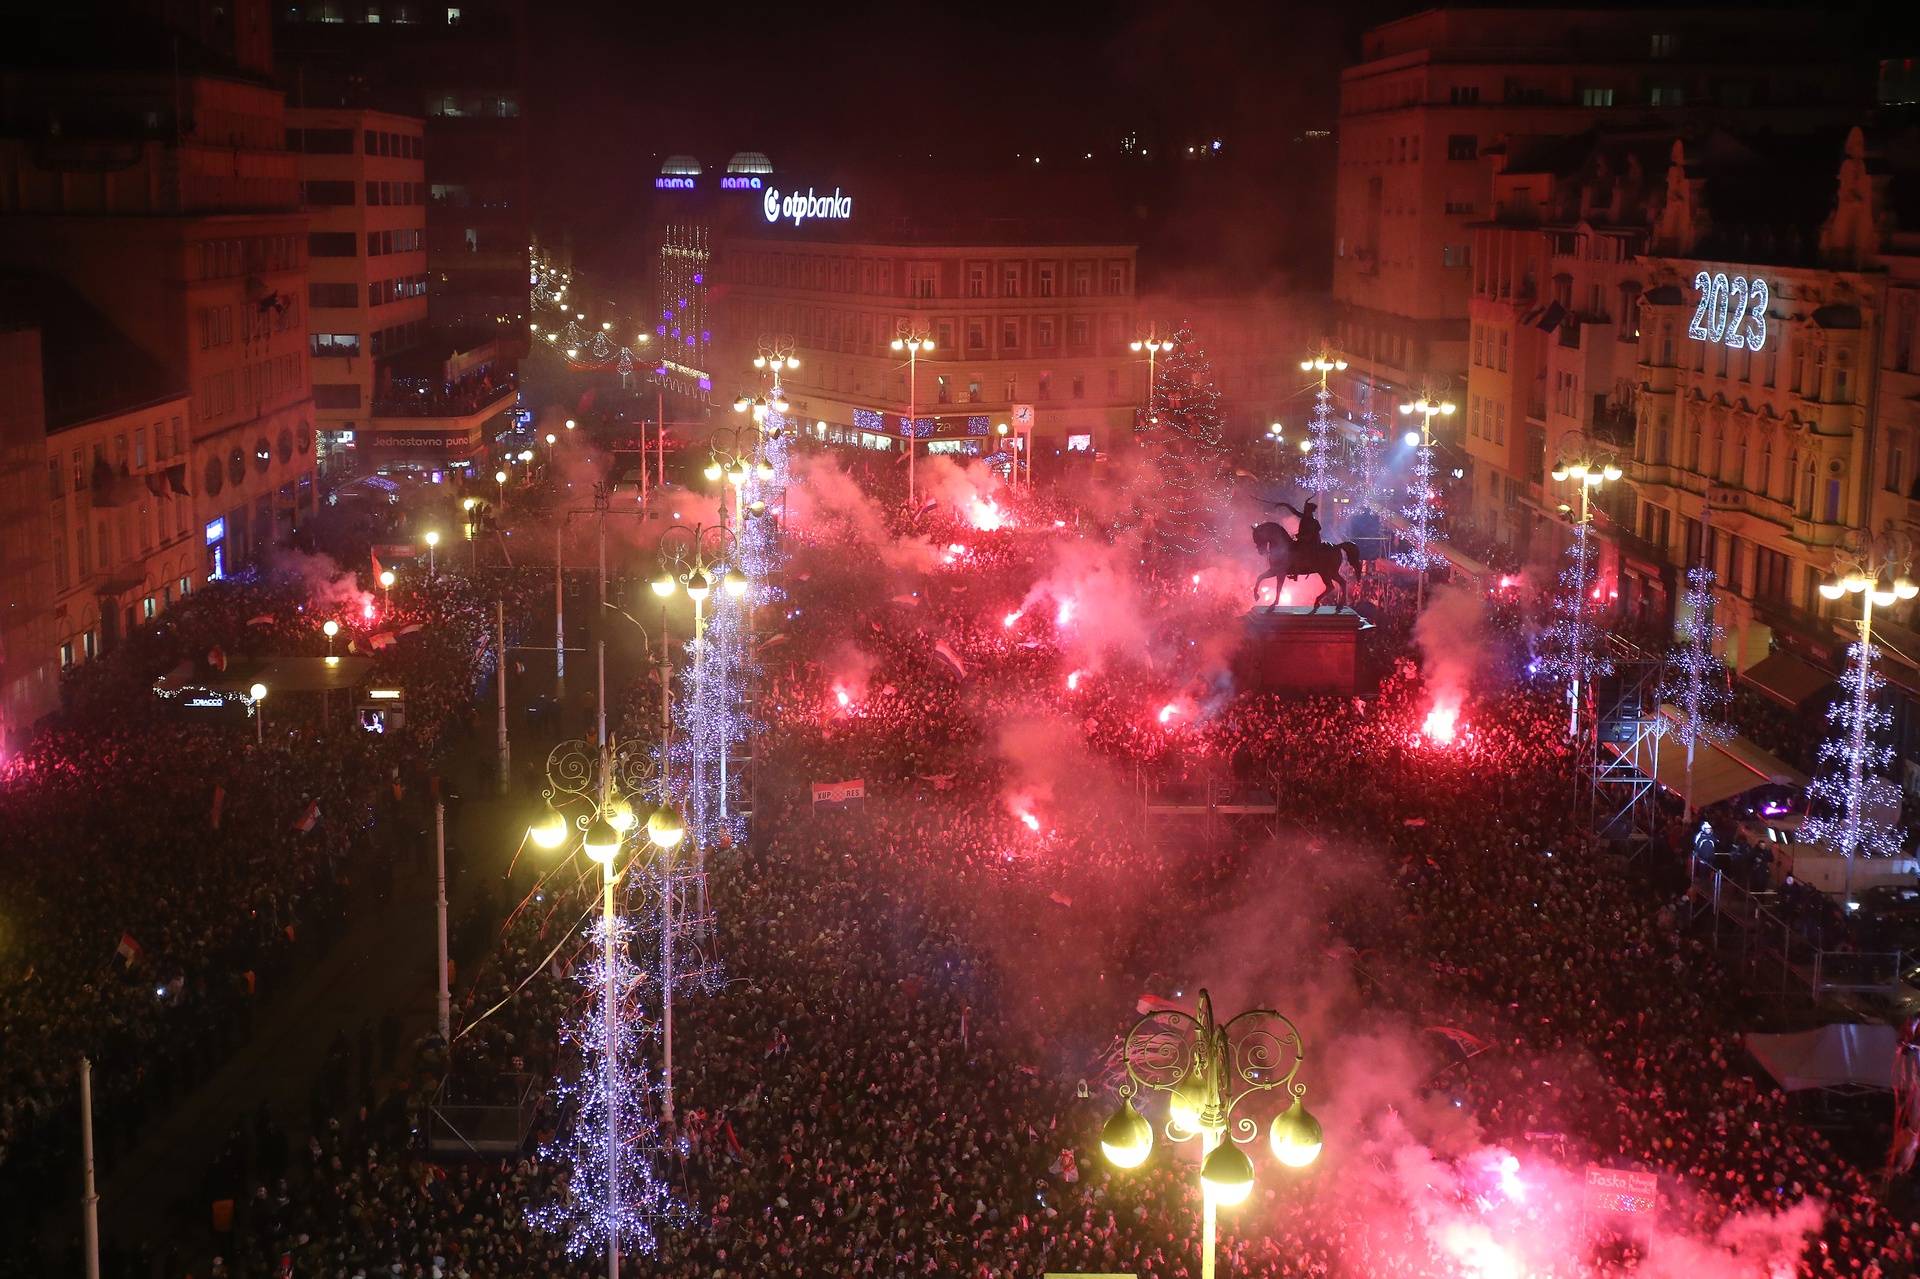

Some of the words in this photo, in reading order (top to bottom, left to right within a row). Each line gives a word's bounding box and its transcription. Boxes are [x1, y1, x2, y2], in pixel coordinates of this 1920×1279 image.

[782, 187, 852, 226] otpbanka
[1689, 271, 1769, 352] 2023
[373, 437, 442, 447] Jednostavno
